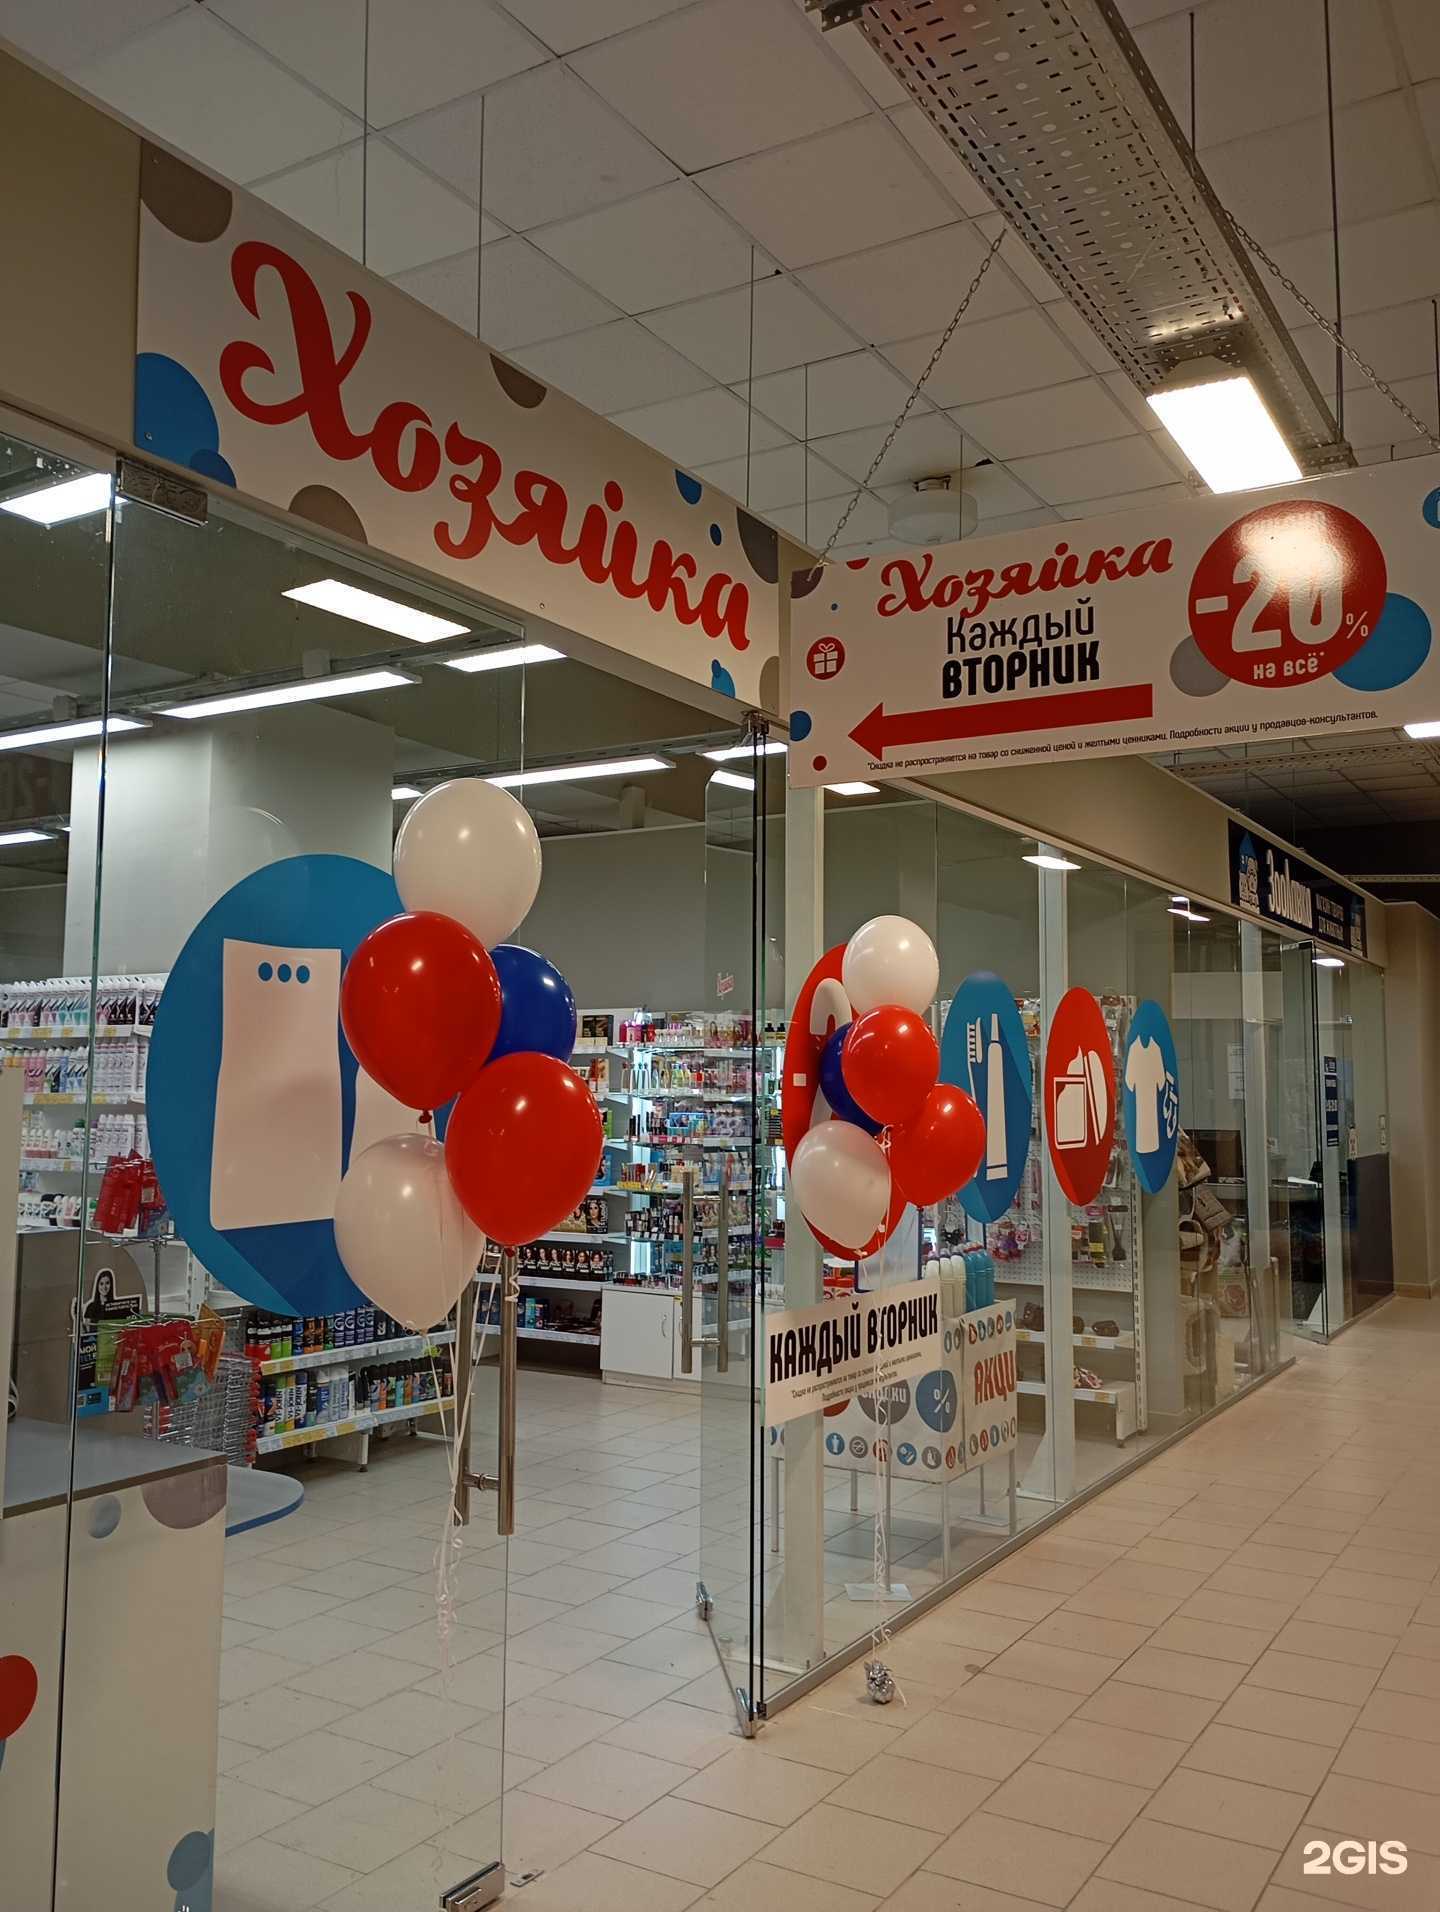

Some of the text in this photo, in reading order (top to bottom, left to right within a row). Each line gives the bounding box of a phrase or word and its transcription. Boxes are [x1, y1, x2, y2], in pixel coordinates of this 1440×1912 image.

[219, 241, 751, 650] Хозяйка
[877, 538, 1173, 618] Хозяйка
[947, 597, 1094, 655] Каждый
[942, 640, 1100, 699] ВТОРНИК
[1253, 662, 1276, 680] на
[904, 753, 967, 769] распространяется
[968, 753, 977, 761] на
[978, 750, 999, 760] товар
[1010, 743, 1052, 756] сниженной
[1053, 740, 1076, 752] ценой
[1077, 742, 1083, 750] и
[1084, 737, 1121, 749] желтыми
[1169, 727, 1223, 740] Подробности
[1224, 723, 1249, 735] акции
[1251, 723, 1258, 733] у
[770, 1301, 861, 1383] КАЖДЫЙ
[868, 1293, 938, 1354] ВТОРНИК
